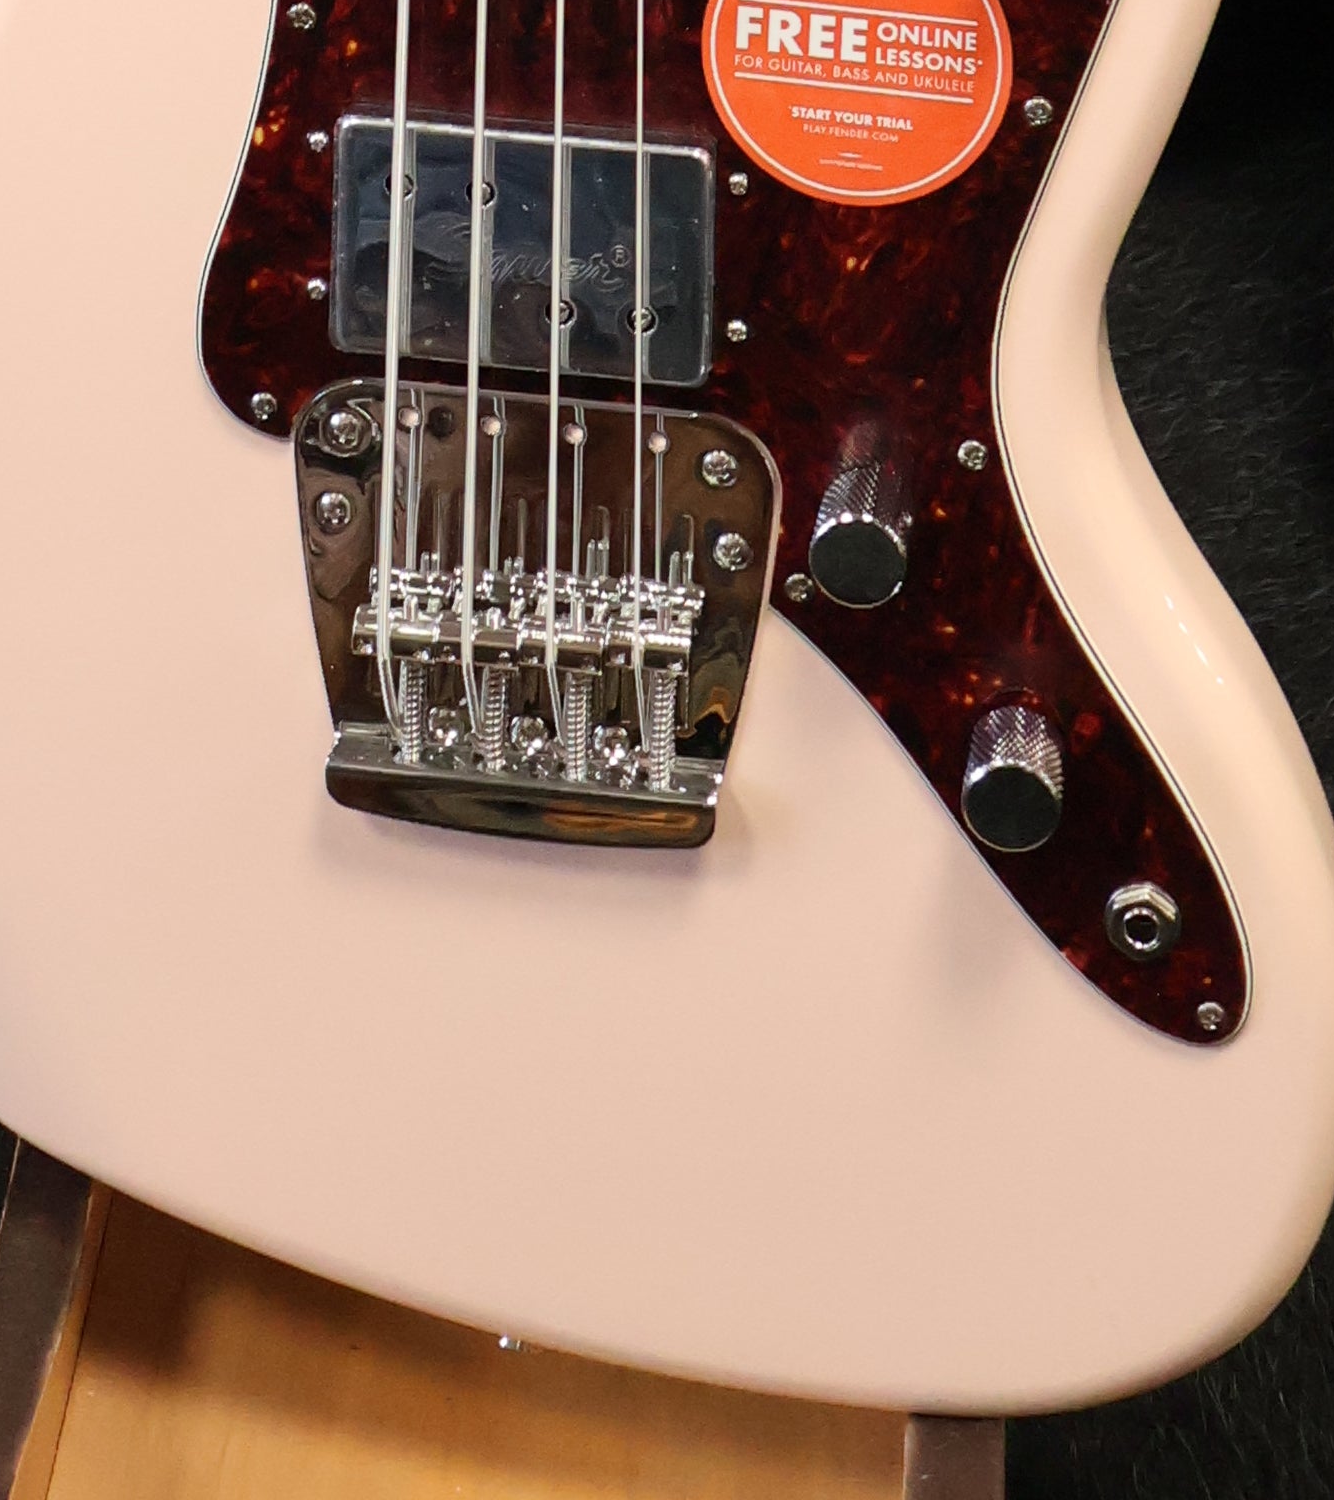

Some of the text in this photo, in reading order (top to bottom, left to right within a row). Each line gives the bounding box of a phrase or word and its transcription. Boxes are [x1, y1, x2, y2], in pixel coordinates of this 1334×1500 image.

[735, 5, 869, 64] FREE
[876, 21, 978, 52] ONLINE
[734, 54, 975, 93] FOR GUITAR, BASS AND UKULELE
[834, 110, 873, 127] YOUR
[876, 115, 914, 131] TRIAL
